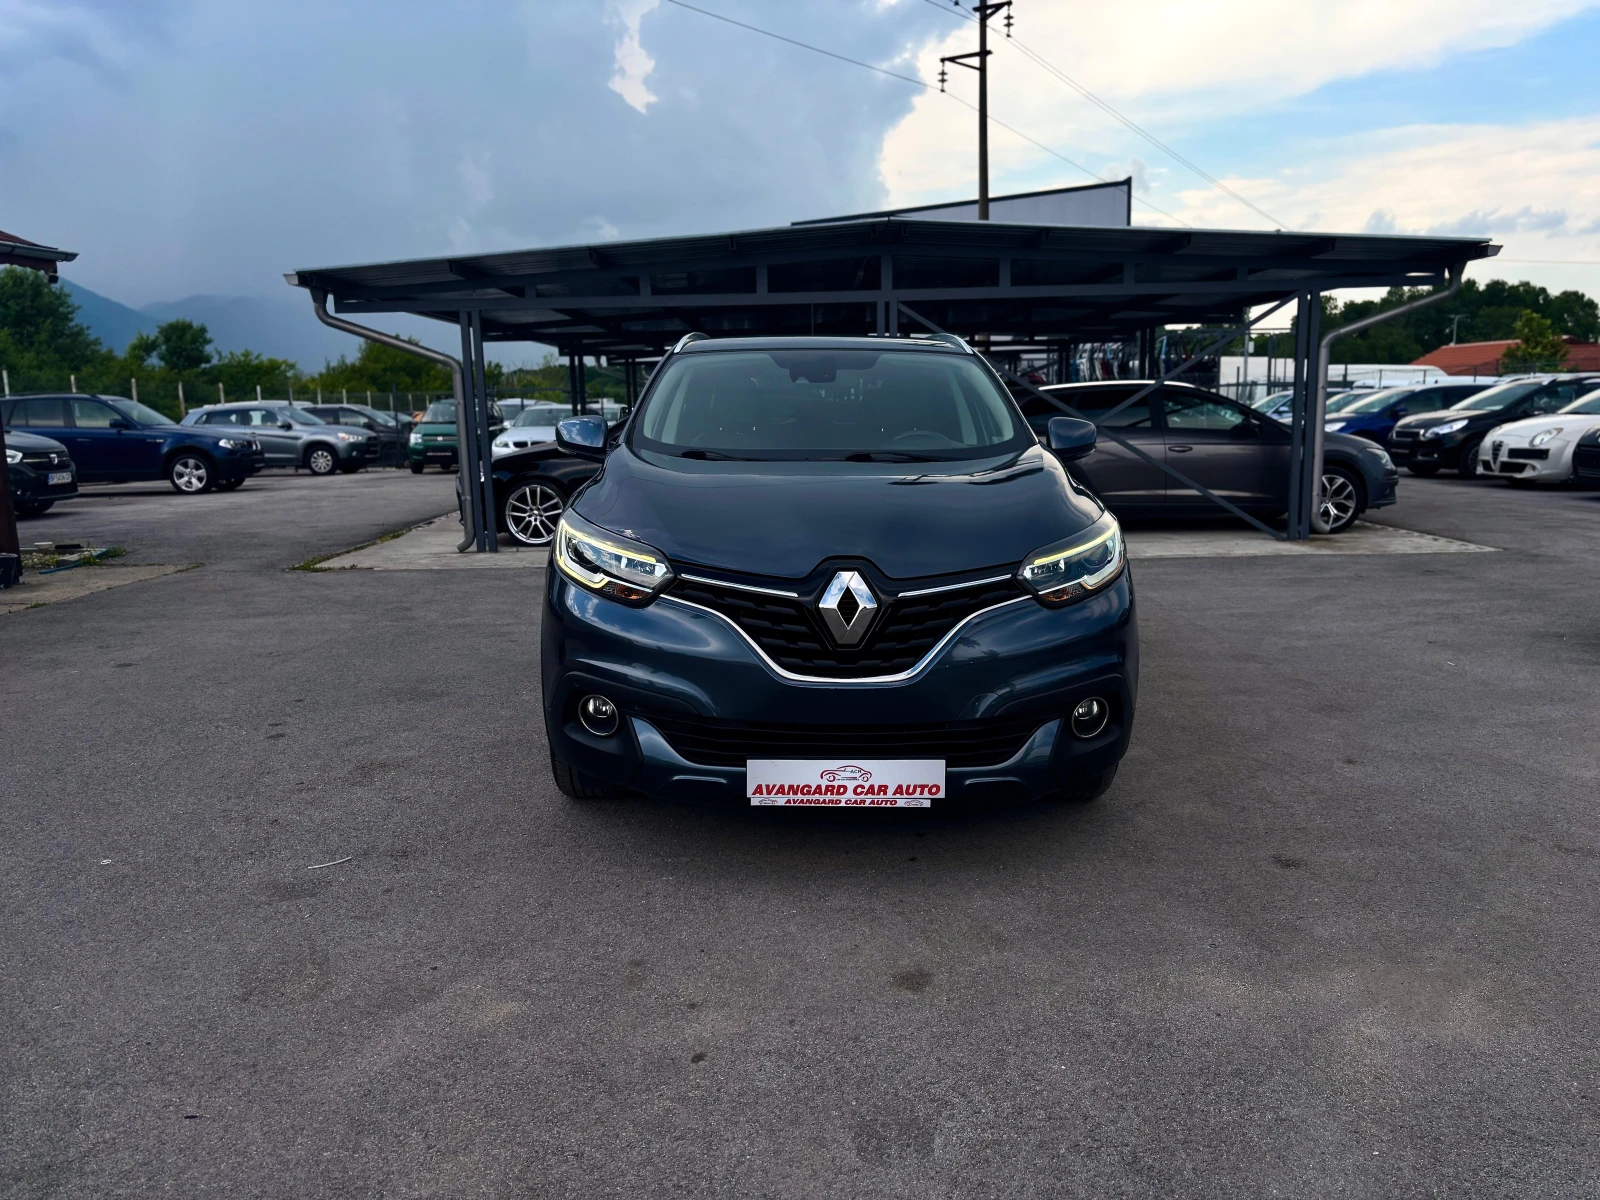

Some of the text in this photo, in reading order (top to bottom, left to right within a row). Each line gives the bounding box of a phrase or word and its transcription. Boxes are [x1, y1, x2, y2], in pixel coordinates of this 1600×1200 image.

[751, 783, 941, 797] AVANGARD CAR AUTO
[784, 798, 842, 806] AVANGARD
[869, 799, 898, 807] AUTO
